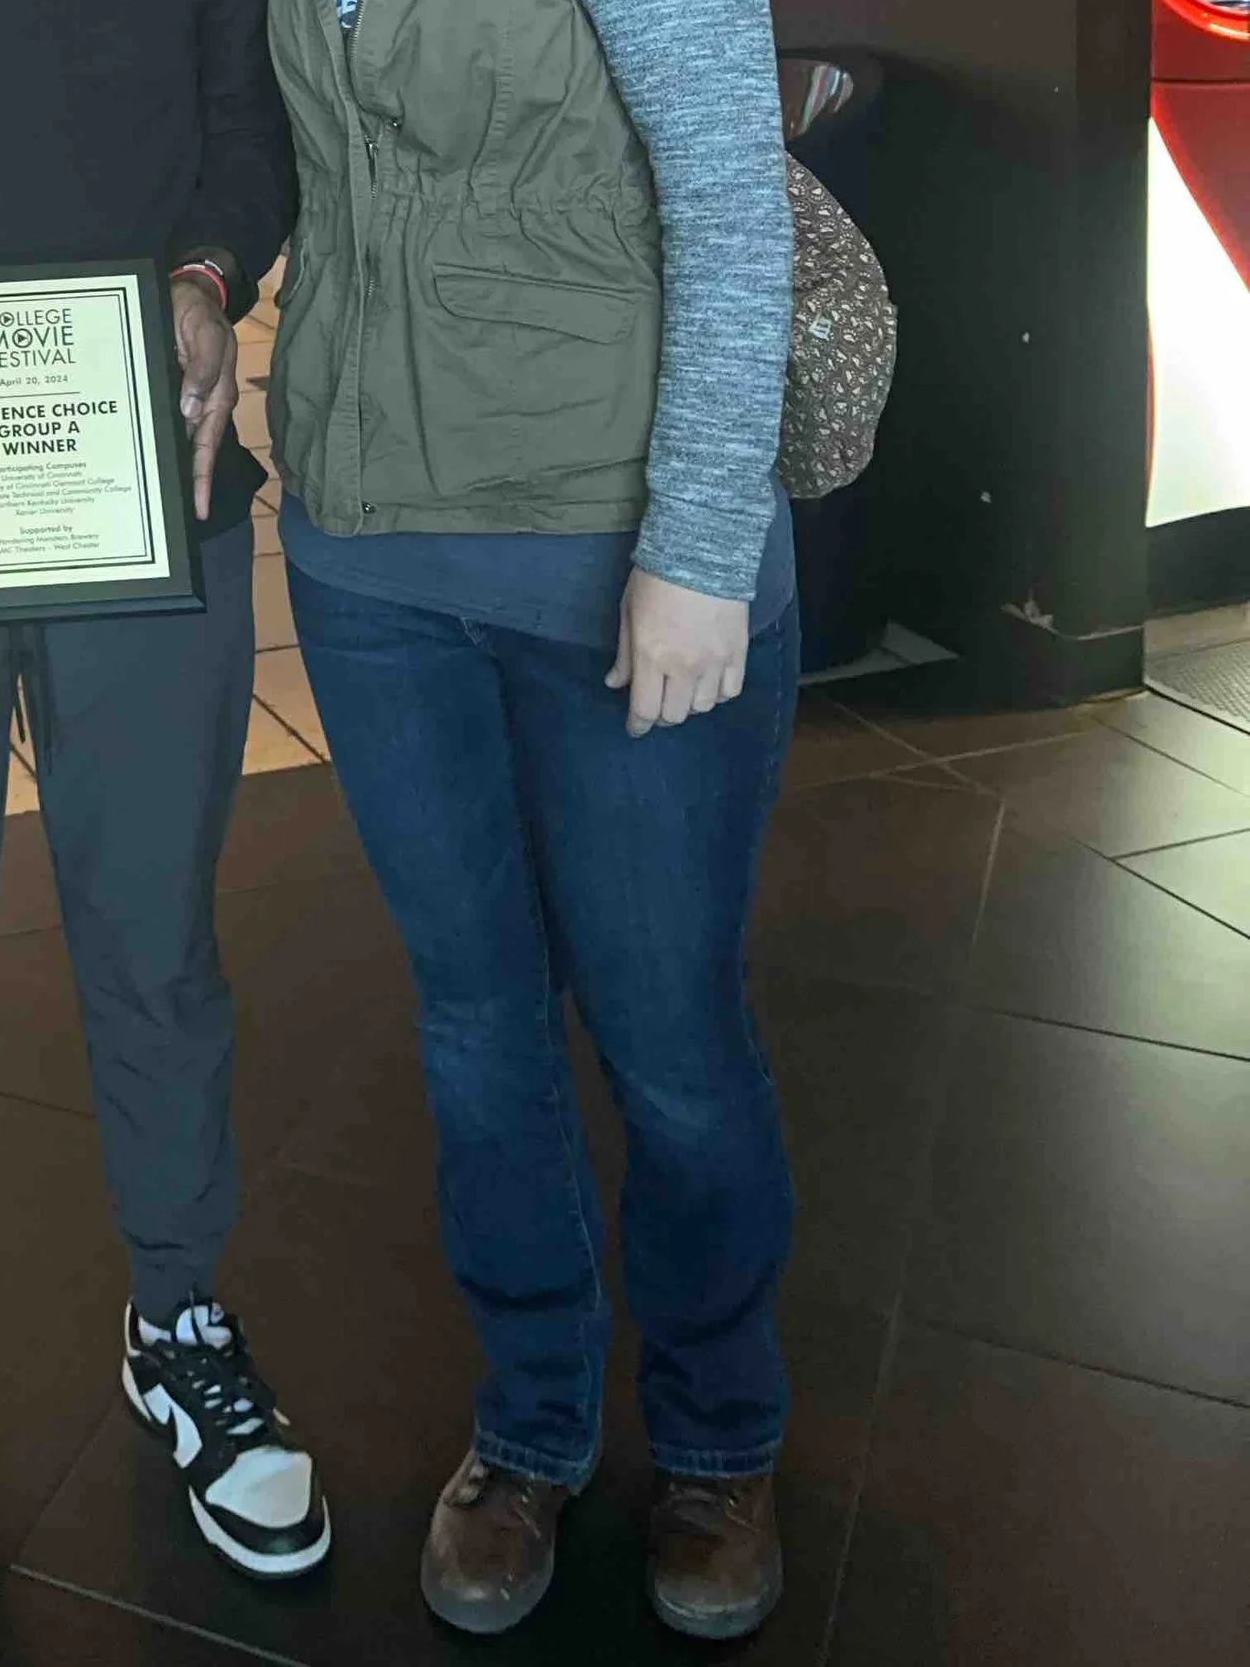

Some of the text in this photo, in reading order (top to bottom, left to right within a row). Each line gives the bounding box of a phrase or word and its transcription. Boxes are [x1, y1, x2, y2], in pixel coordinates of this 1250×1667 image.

[0, 374, 69, 387] April 20, 2024
[52, 400, 118, 417] CHOICE
[68, 420, 81, 434] A
[2, 438, 77, 455] WINNER
[46, 461, 86, 470] Campuses
[1, 473, 35, 481] University
[87, 477, 115, 485] College
[104, 485, 132, 493] College
[27, 498, 59, 506] Kentucky
[19, 524, 73, 534] Supported by
